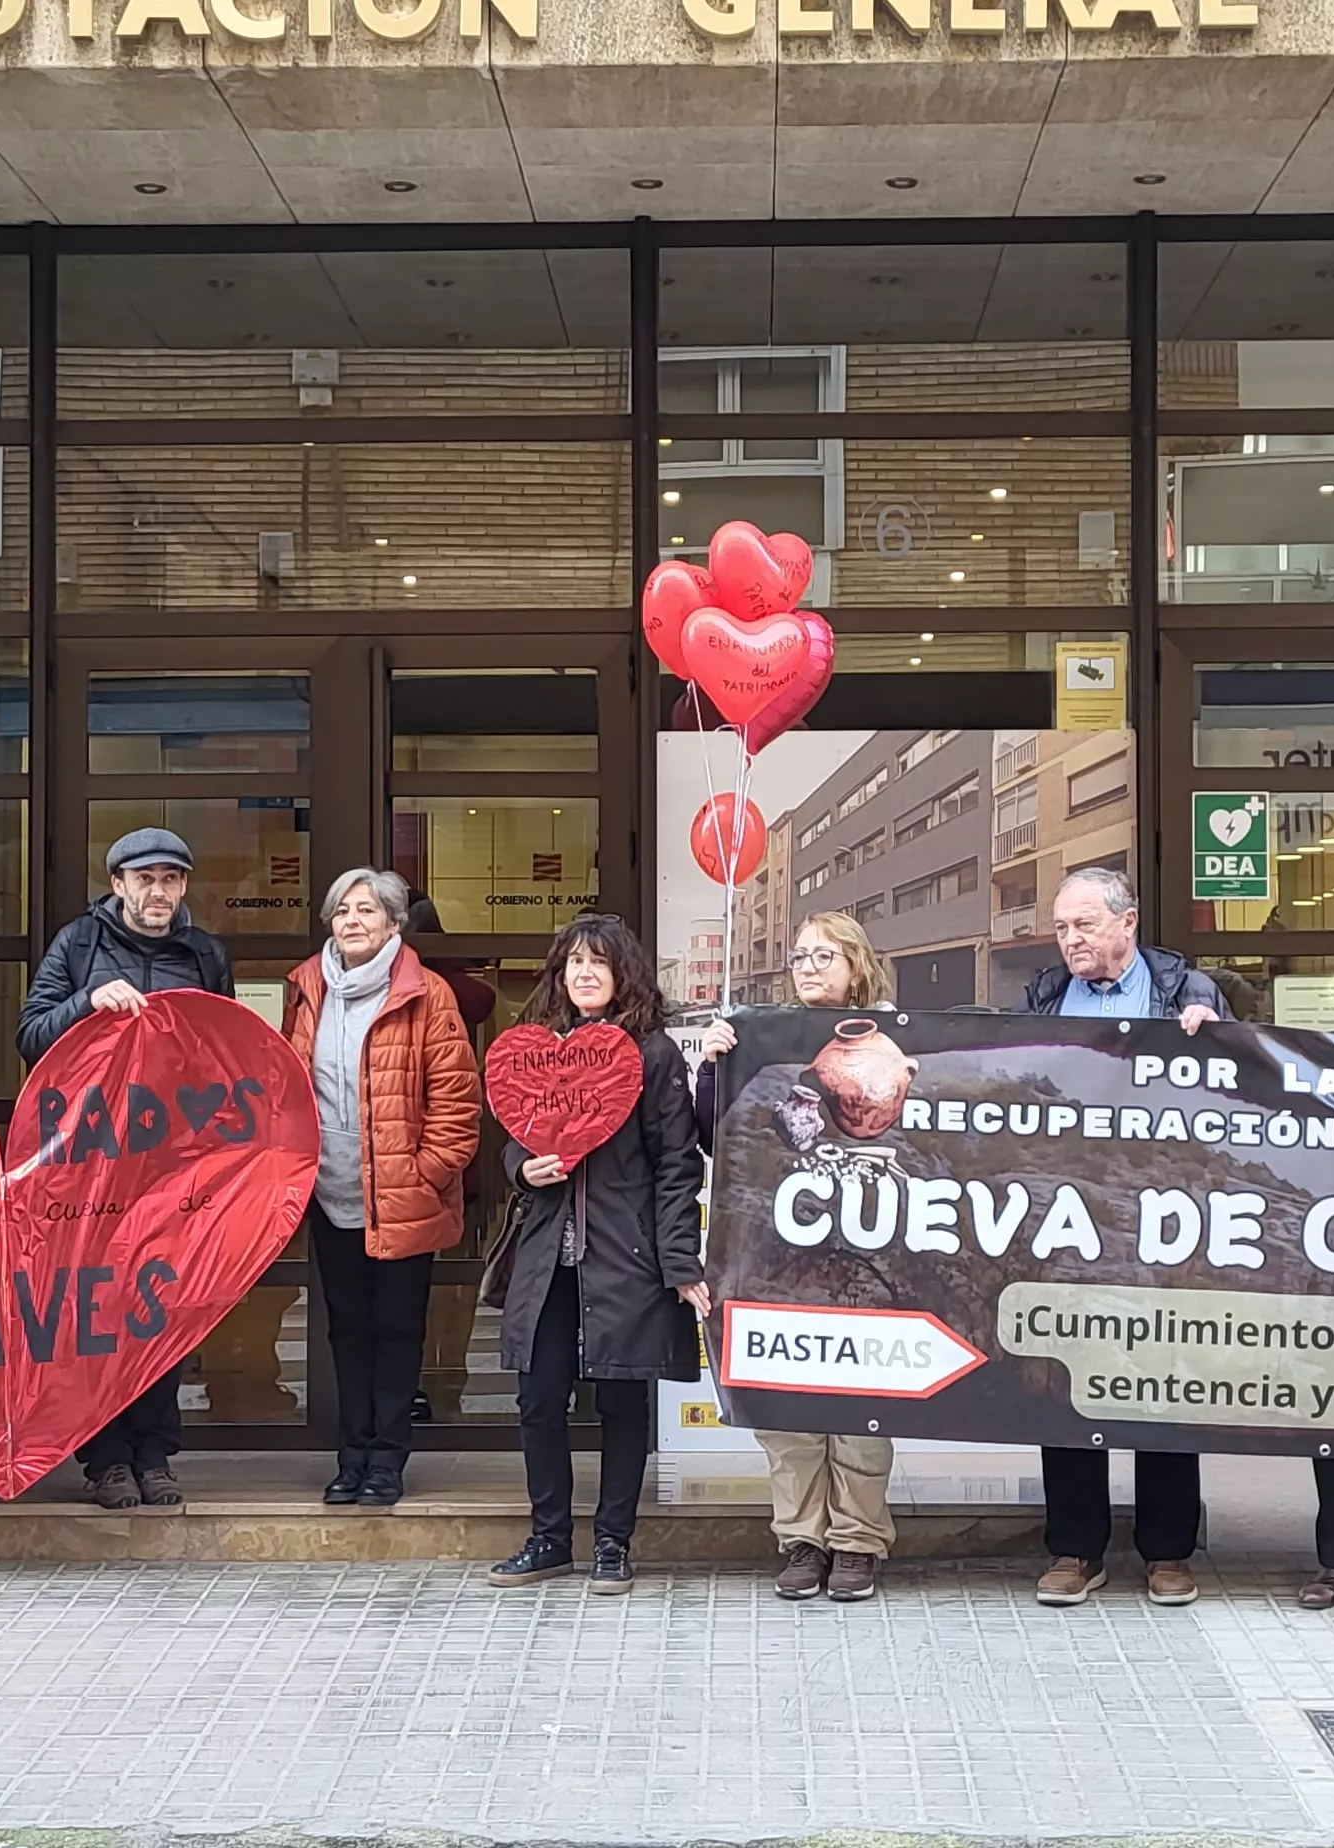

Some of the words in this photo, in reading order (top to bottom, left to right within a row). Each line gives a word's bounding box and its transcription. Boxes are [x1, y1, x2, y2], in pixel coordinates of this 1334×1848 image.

[1205, 855, 1256, 876] DEA
[225, 897, 283, 908] GOBIERNO
[287, 897, 303, 908] DE
[485, 895, 543, 905] GOBIERNO
[548, 895, 563, 905] DE
[1132, 1055, 1239, 1089] POR
[520, 1087, 602, 1119] CHAVES
[178, 1192, 214, 1215] de
[772, 1170, 1104, 1263] CUEVA
[1136, 1187, 1268, 1270] DE
[1087, 1372, 1298, 1410] sentencia
